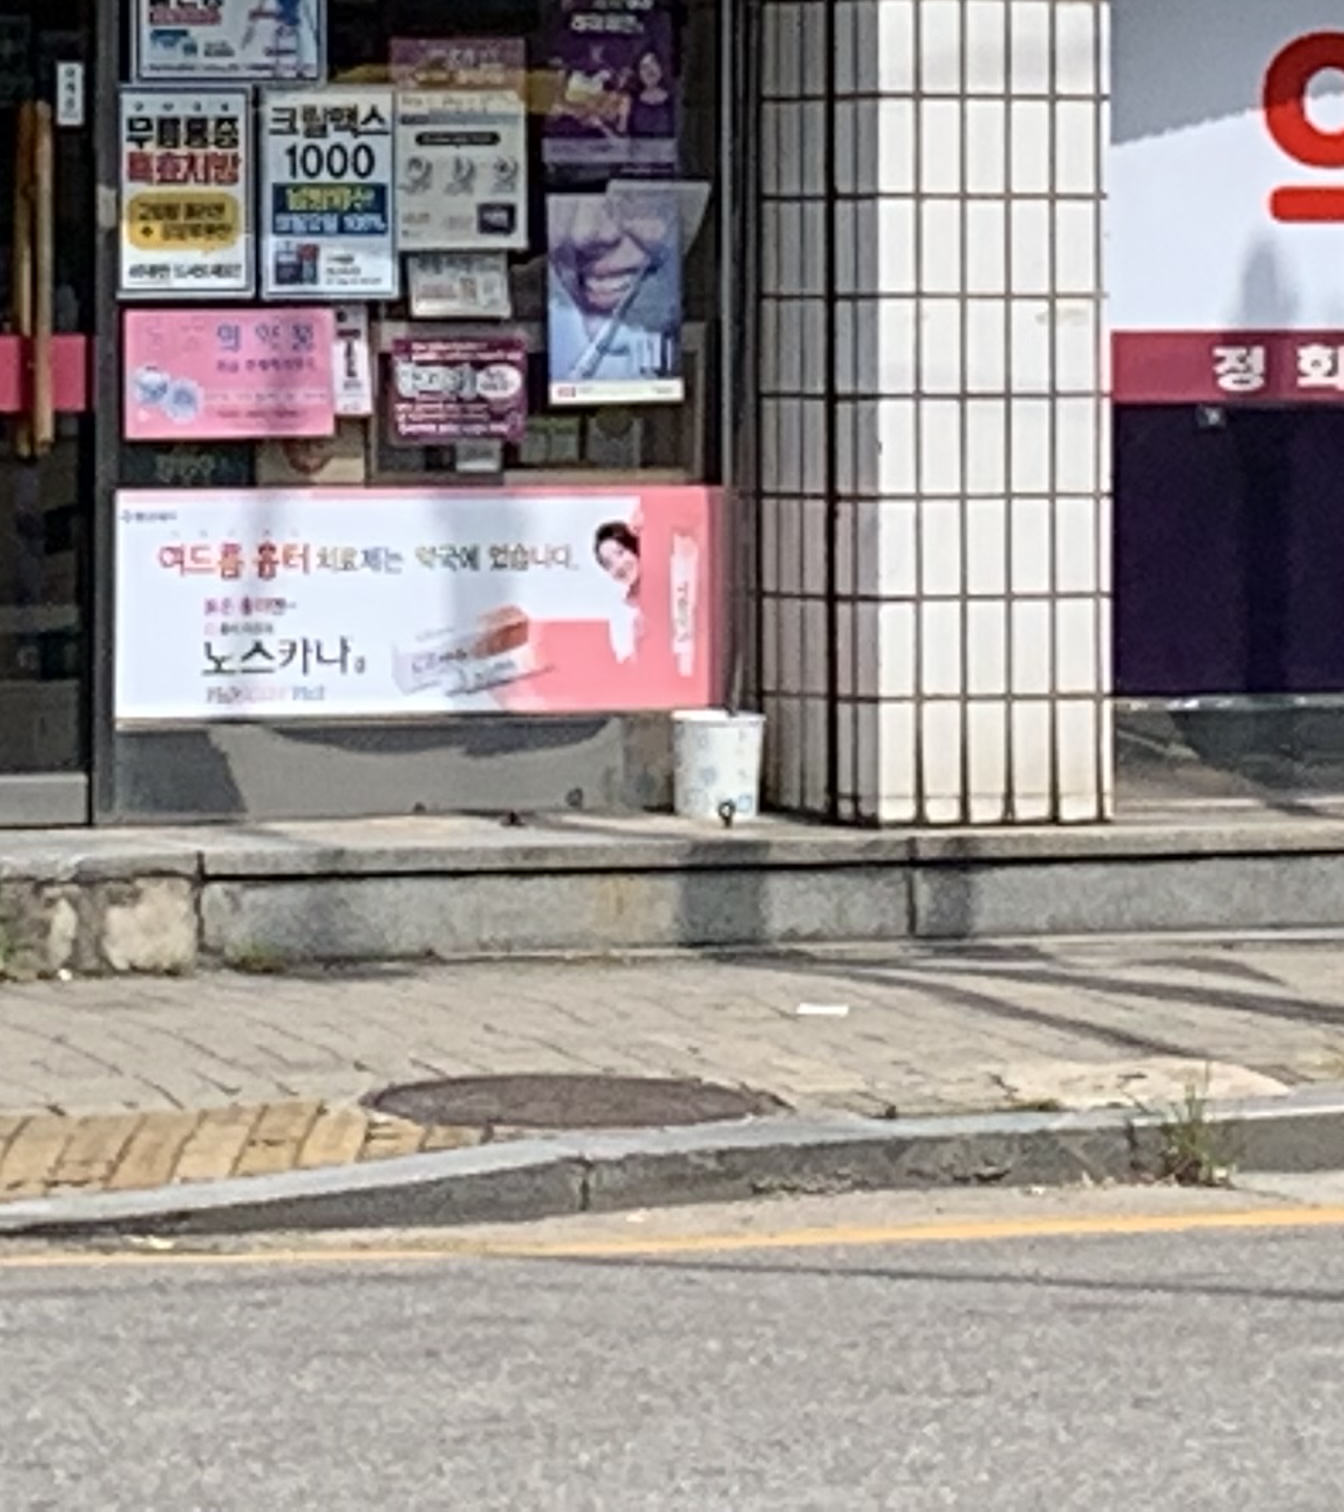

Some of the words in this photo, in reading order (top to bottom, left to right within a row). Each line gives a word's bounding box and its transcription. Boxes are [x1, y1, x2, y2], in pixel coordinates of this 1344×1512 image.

[284, 142, 377, 180] 1000
[158, 541, 244, 579] 여드름
[315, 548, 403, 576] 치료제는
[414, 544, 481, 573] 약국에
